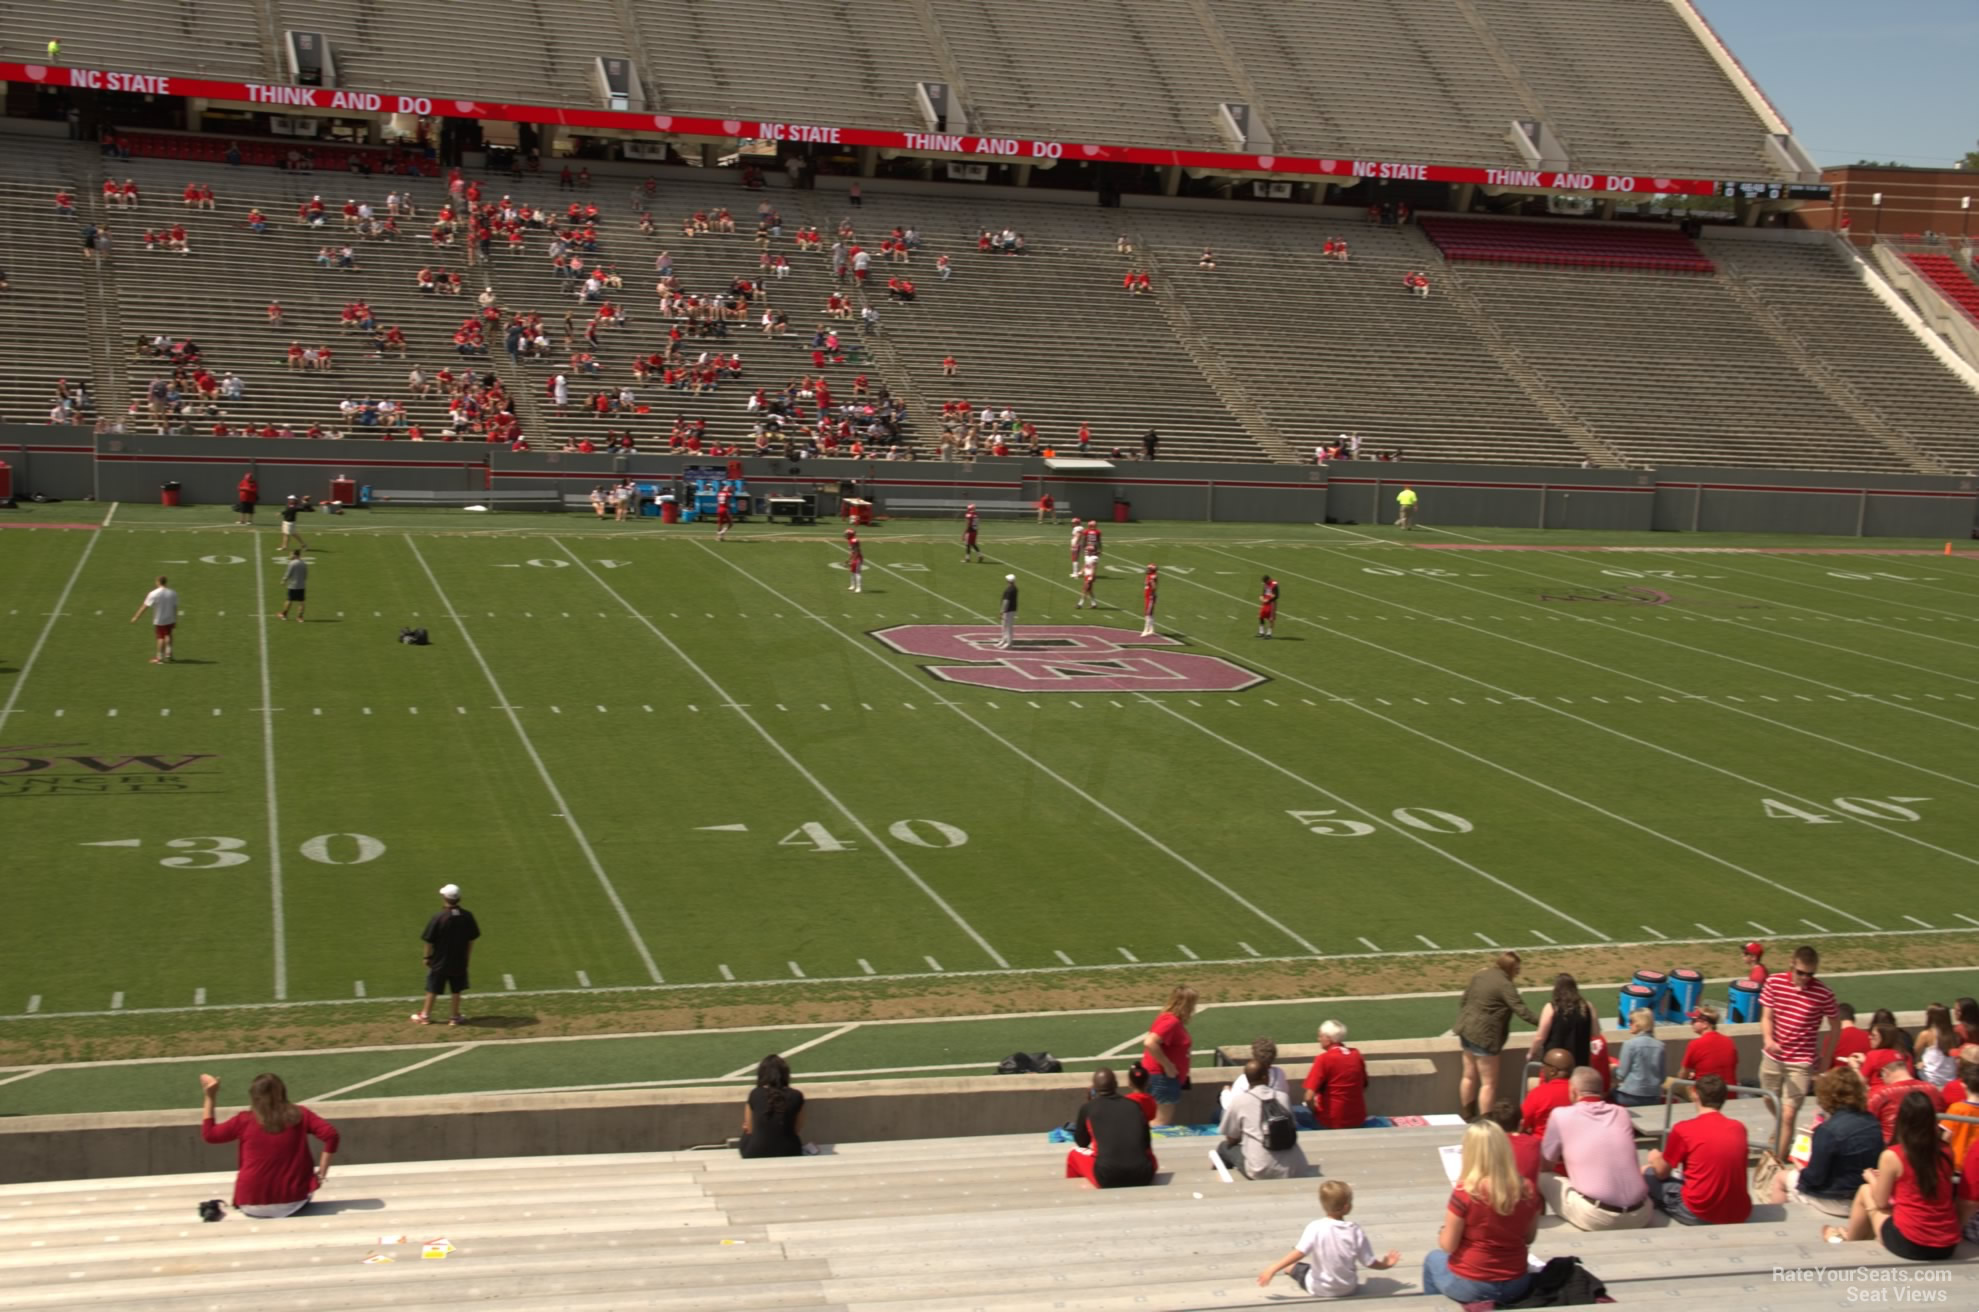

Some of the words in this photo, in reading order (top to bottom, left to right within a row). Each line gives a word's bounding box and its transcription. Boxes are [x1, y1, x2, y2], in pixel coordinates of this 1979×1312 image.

[70, 68, 101, 89] NC
[106, 72, 170, 95] STATE
[245, 83, 317, 107] THINK
[330, 91, 382, 112] AND
[397, 96, 433, 116] DO
[759, 122, 785, 141] NC
[788, 124, 841, 145] STATE
[903, 132, 964, 153] THINK
[975, 137, 1020, 156] AND
[1032, 141, 1063, 159] DO
[1352, 160, 1377, 178] NC
[1379, 162, 1429, 181] STATE
[1486, 168, 1542, 188] THINK
[1552, 172, 1594, 191] AND
[1606, 175, 1636, 193] DO
